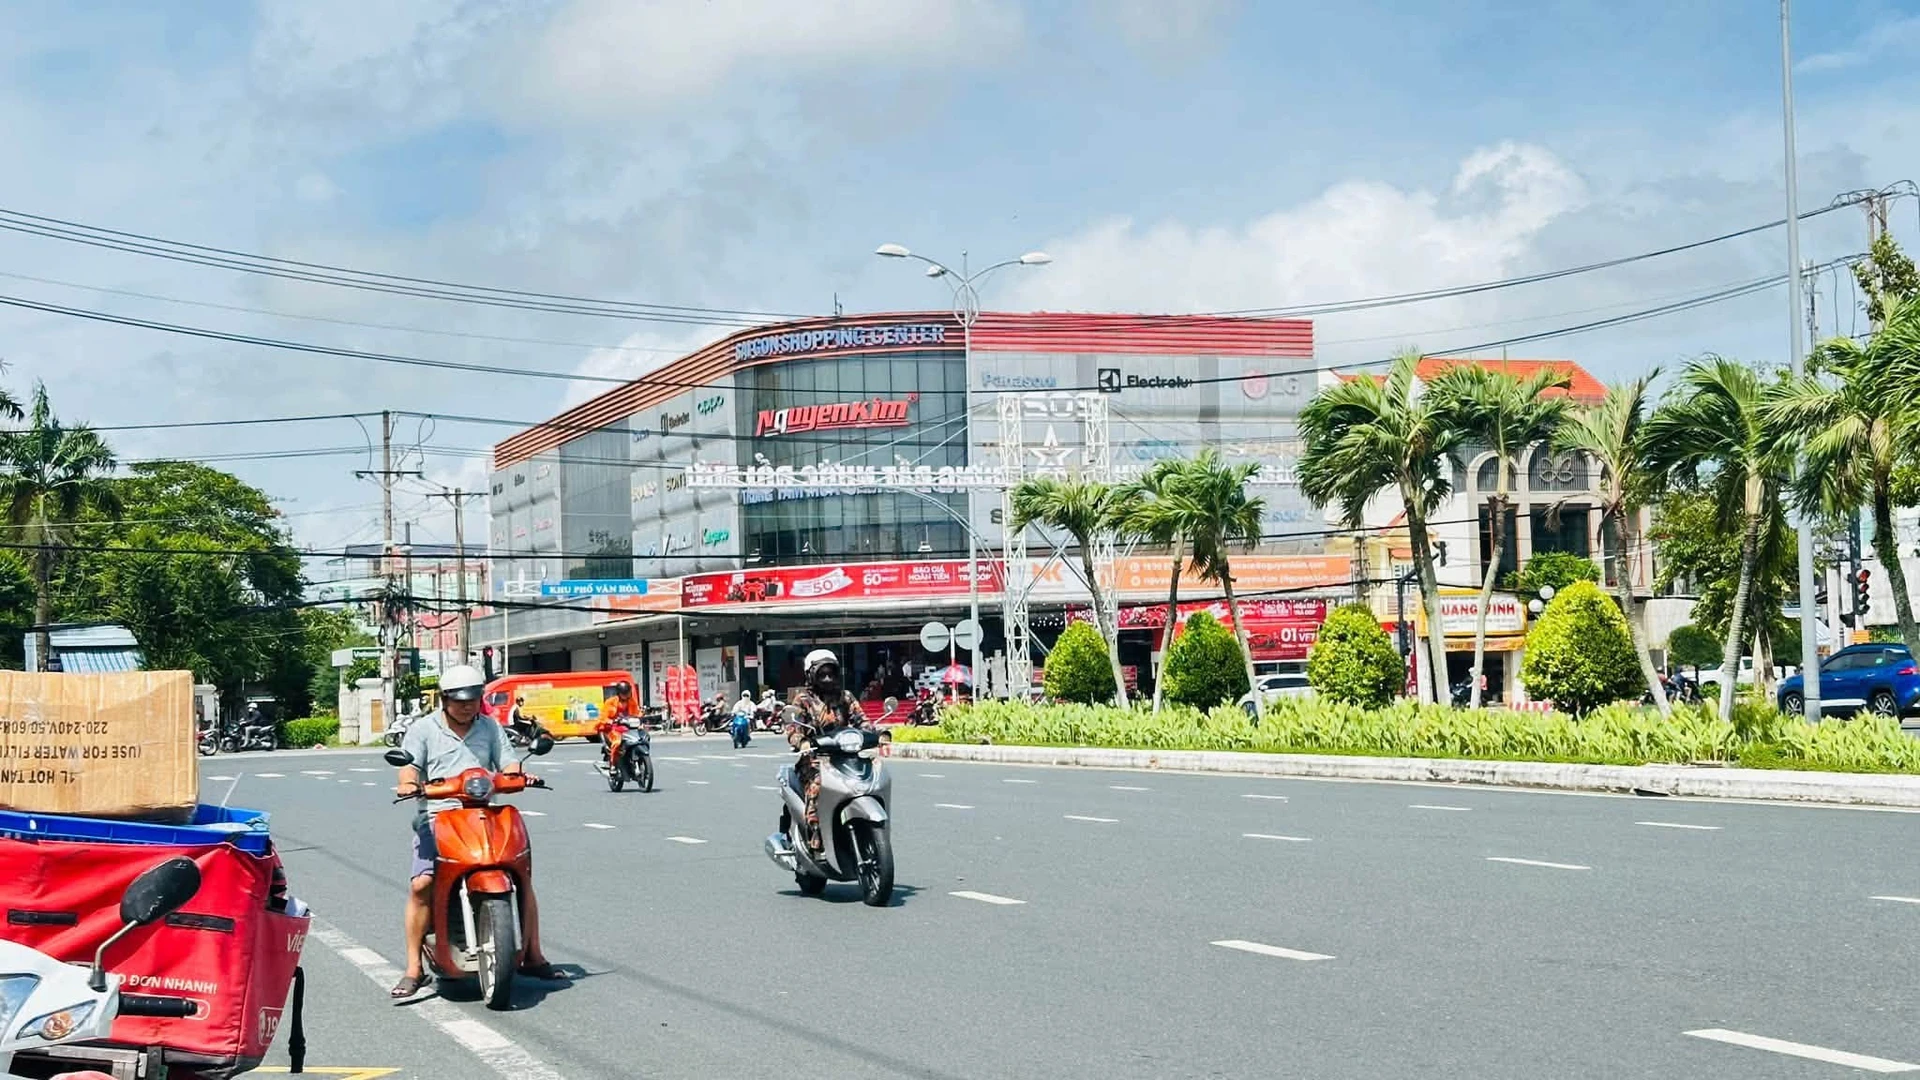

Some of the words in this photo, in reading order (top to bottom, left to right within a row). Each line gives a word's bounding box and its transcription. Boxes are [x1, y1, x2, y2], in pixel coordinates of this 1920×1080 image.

[756, 397, 911, 438] NguyenKim
[1441, 603, 1478, 616] UANG
[34, 745, 79, 760] WATER
[82, 745, 108, 759] FOR
[28, 769, 55, 784] HOT
[164, 978, 217, 995] NHANH!
